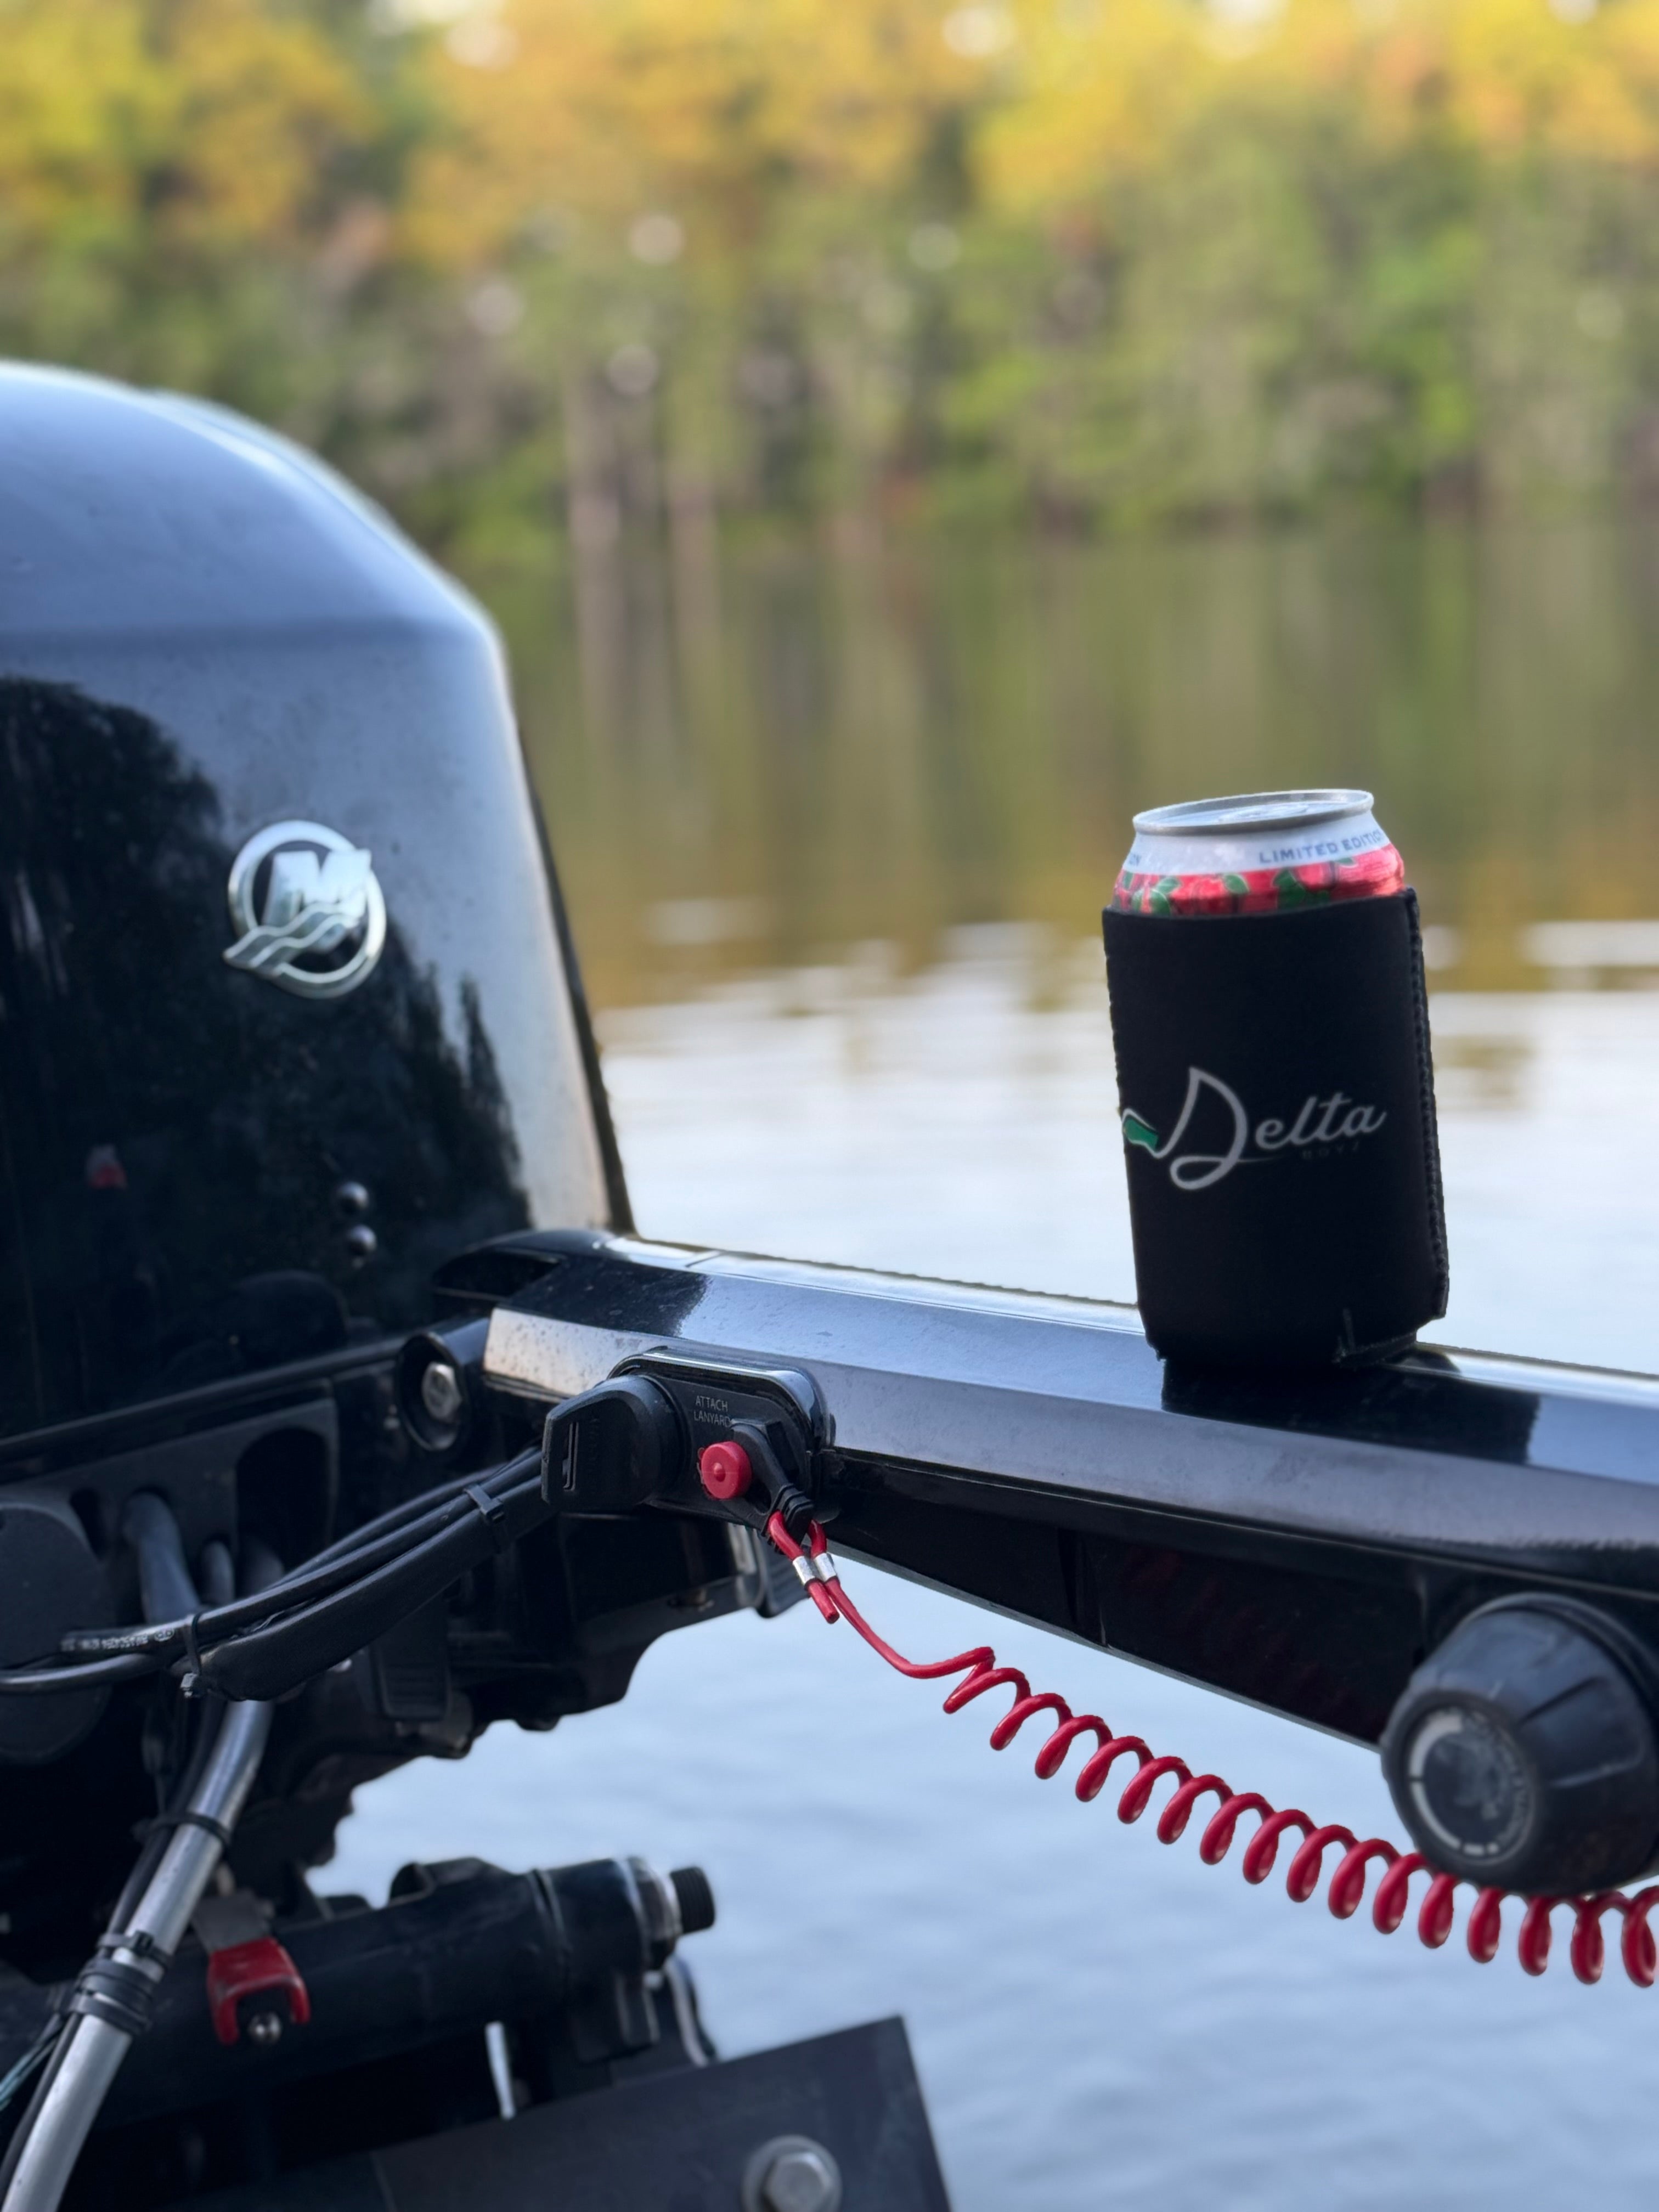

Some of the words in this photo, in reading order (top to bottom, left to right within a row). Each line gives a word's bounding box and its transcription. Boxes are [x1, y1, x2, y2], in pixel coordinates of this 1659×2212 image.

[1259, 842, 1339, 864] LIMITED
[1341, 828, 1382, 850] EDITIO
[1150, 1066, 1387, 1190] Delta
[695, 1395, 729, 1412] ATTACH
[693, 1409, 732, 1427] LANYARD
